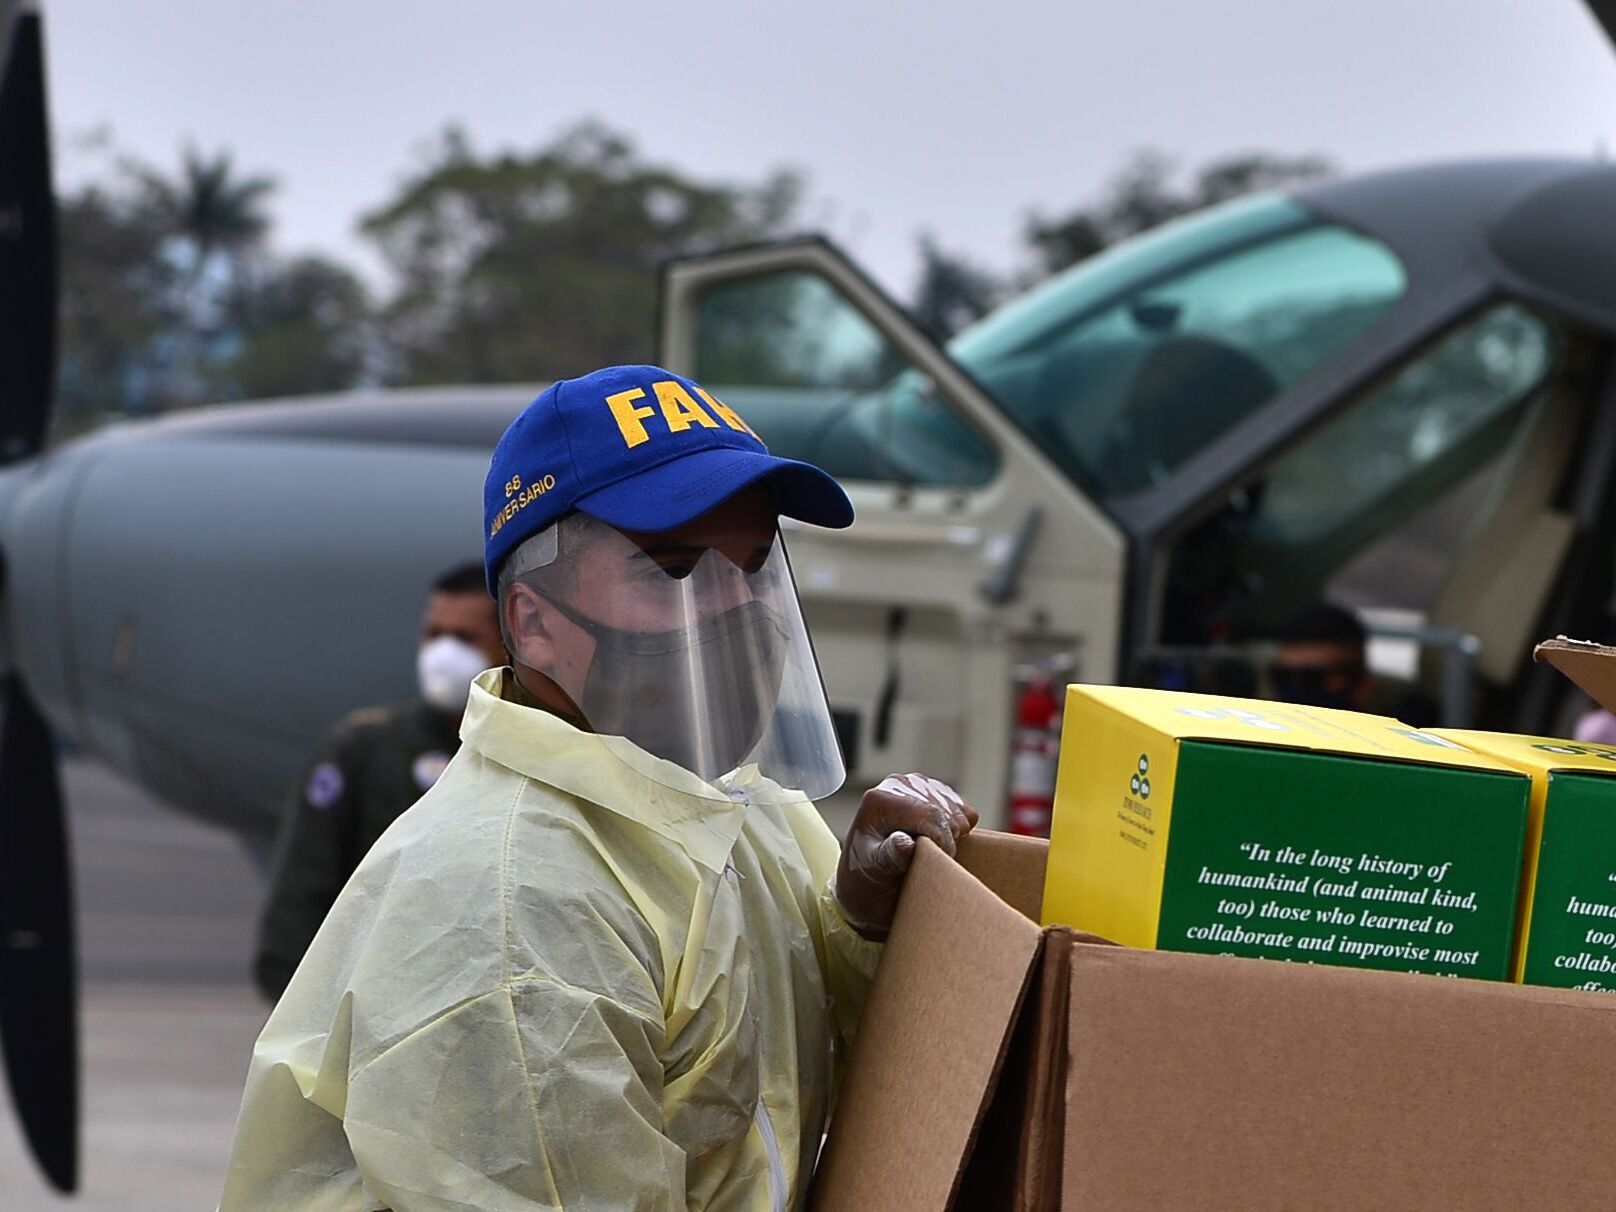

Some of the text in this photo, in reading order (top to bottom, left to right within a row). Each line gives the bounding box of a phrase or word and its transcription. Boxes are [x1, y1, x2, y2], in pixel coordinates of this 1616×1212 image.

[1240, 842, 1453, 883] “In the long history of
[1198, 867, 1478, 912] humankind (and animal kind,
[1217, 899, 1454, 935] too) those who learned to
[1186, 924, 1480, 965] collaborate and improvise most
